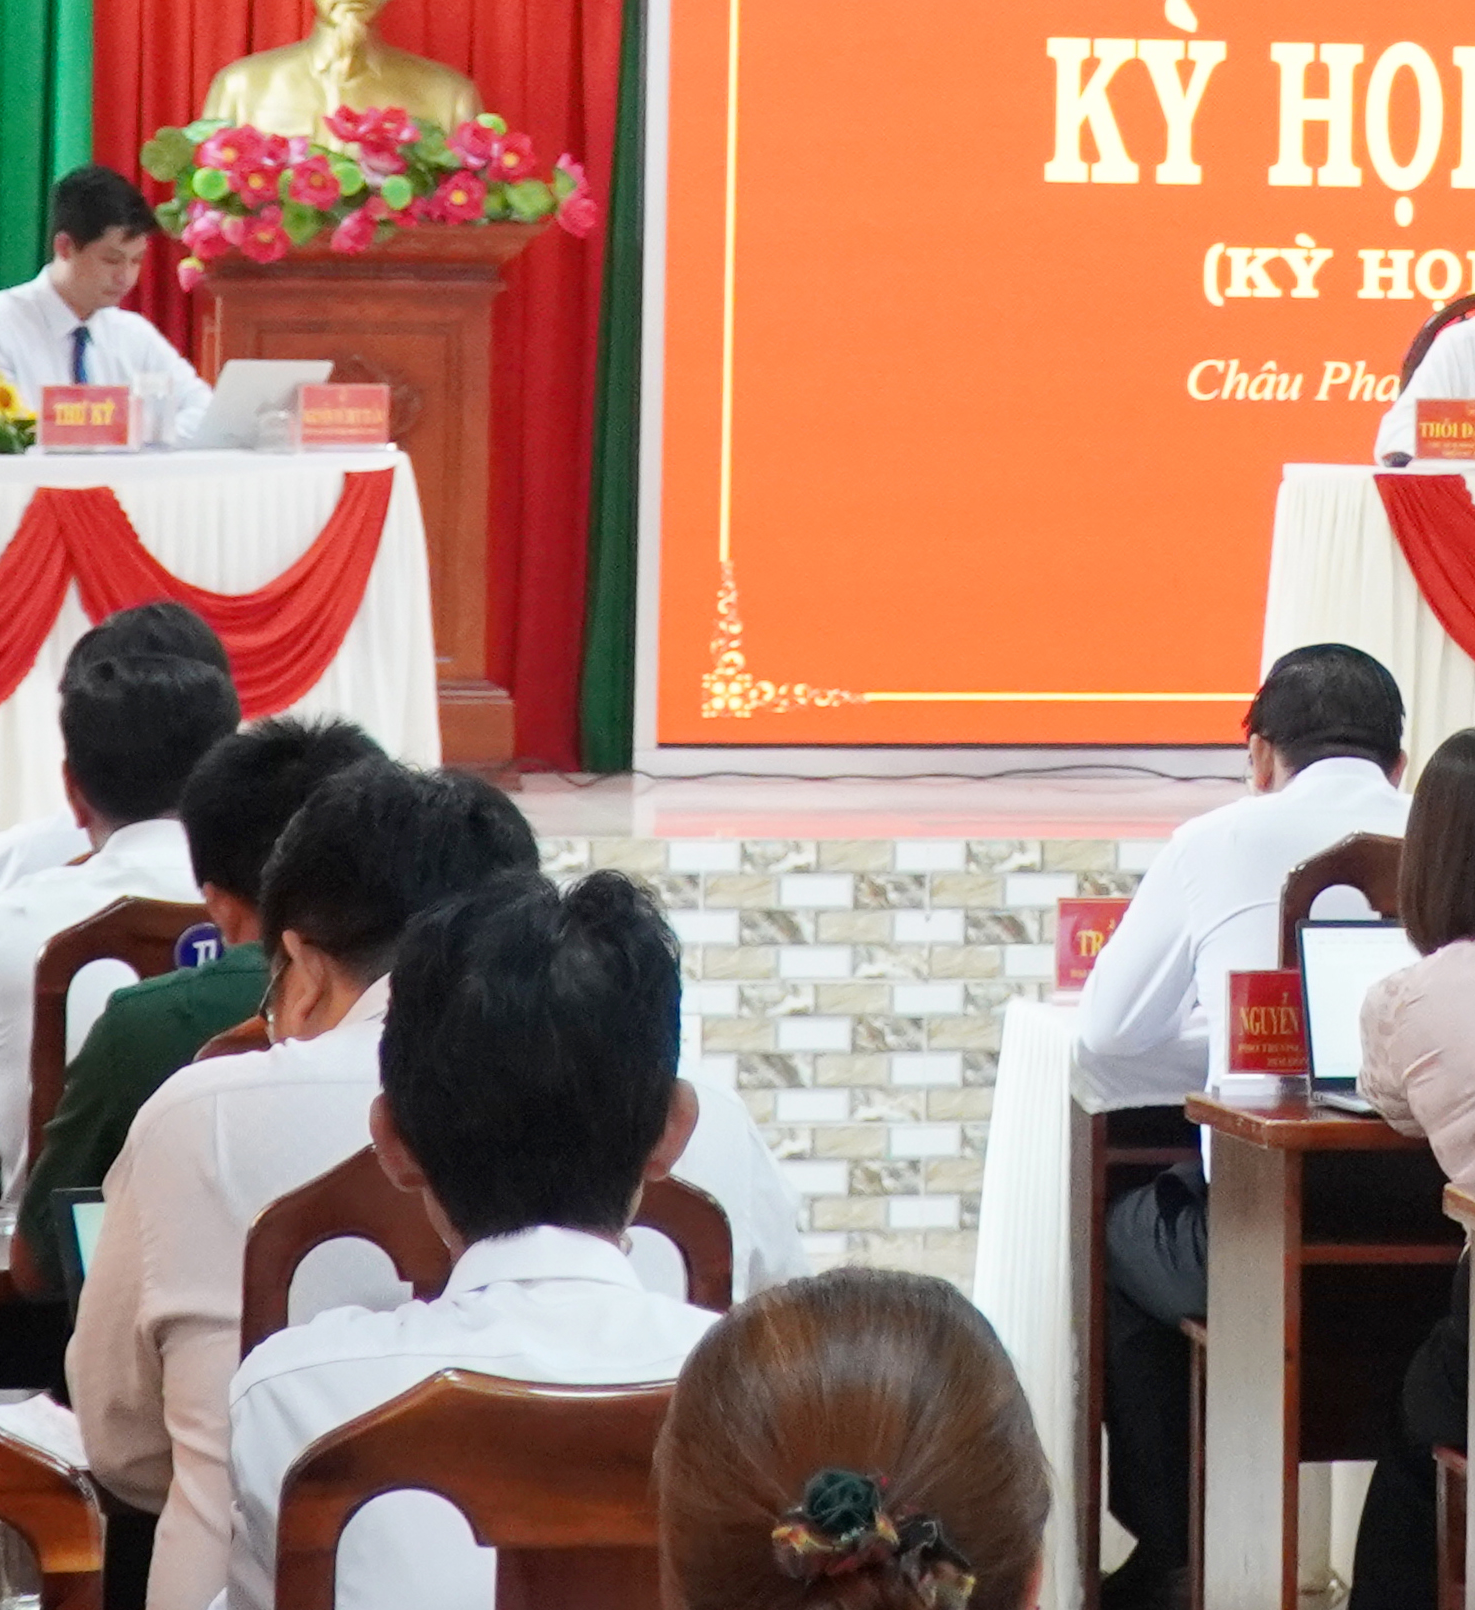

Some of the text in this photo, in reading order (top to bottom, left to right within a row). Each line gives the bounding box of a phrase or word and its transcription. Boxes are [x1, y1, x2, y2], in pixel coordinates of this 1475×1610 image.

[1203, 236, 1334, 307] (KỲ
[1185, 359, 1305, 403] Châu
[1077, 919, 1116, 957] TR
